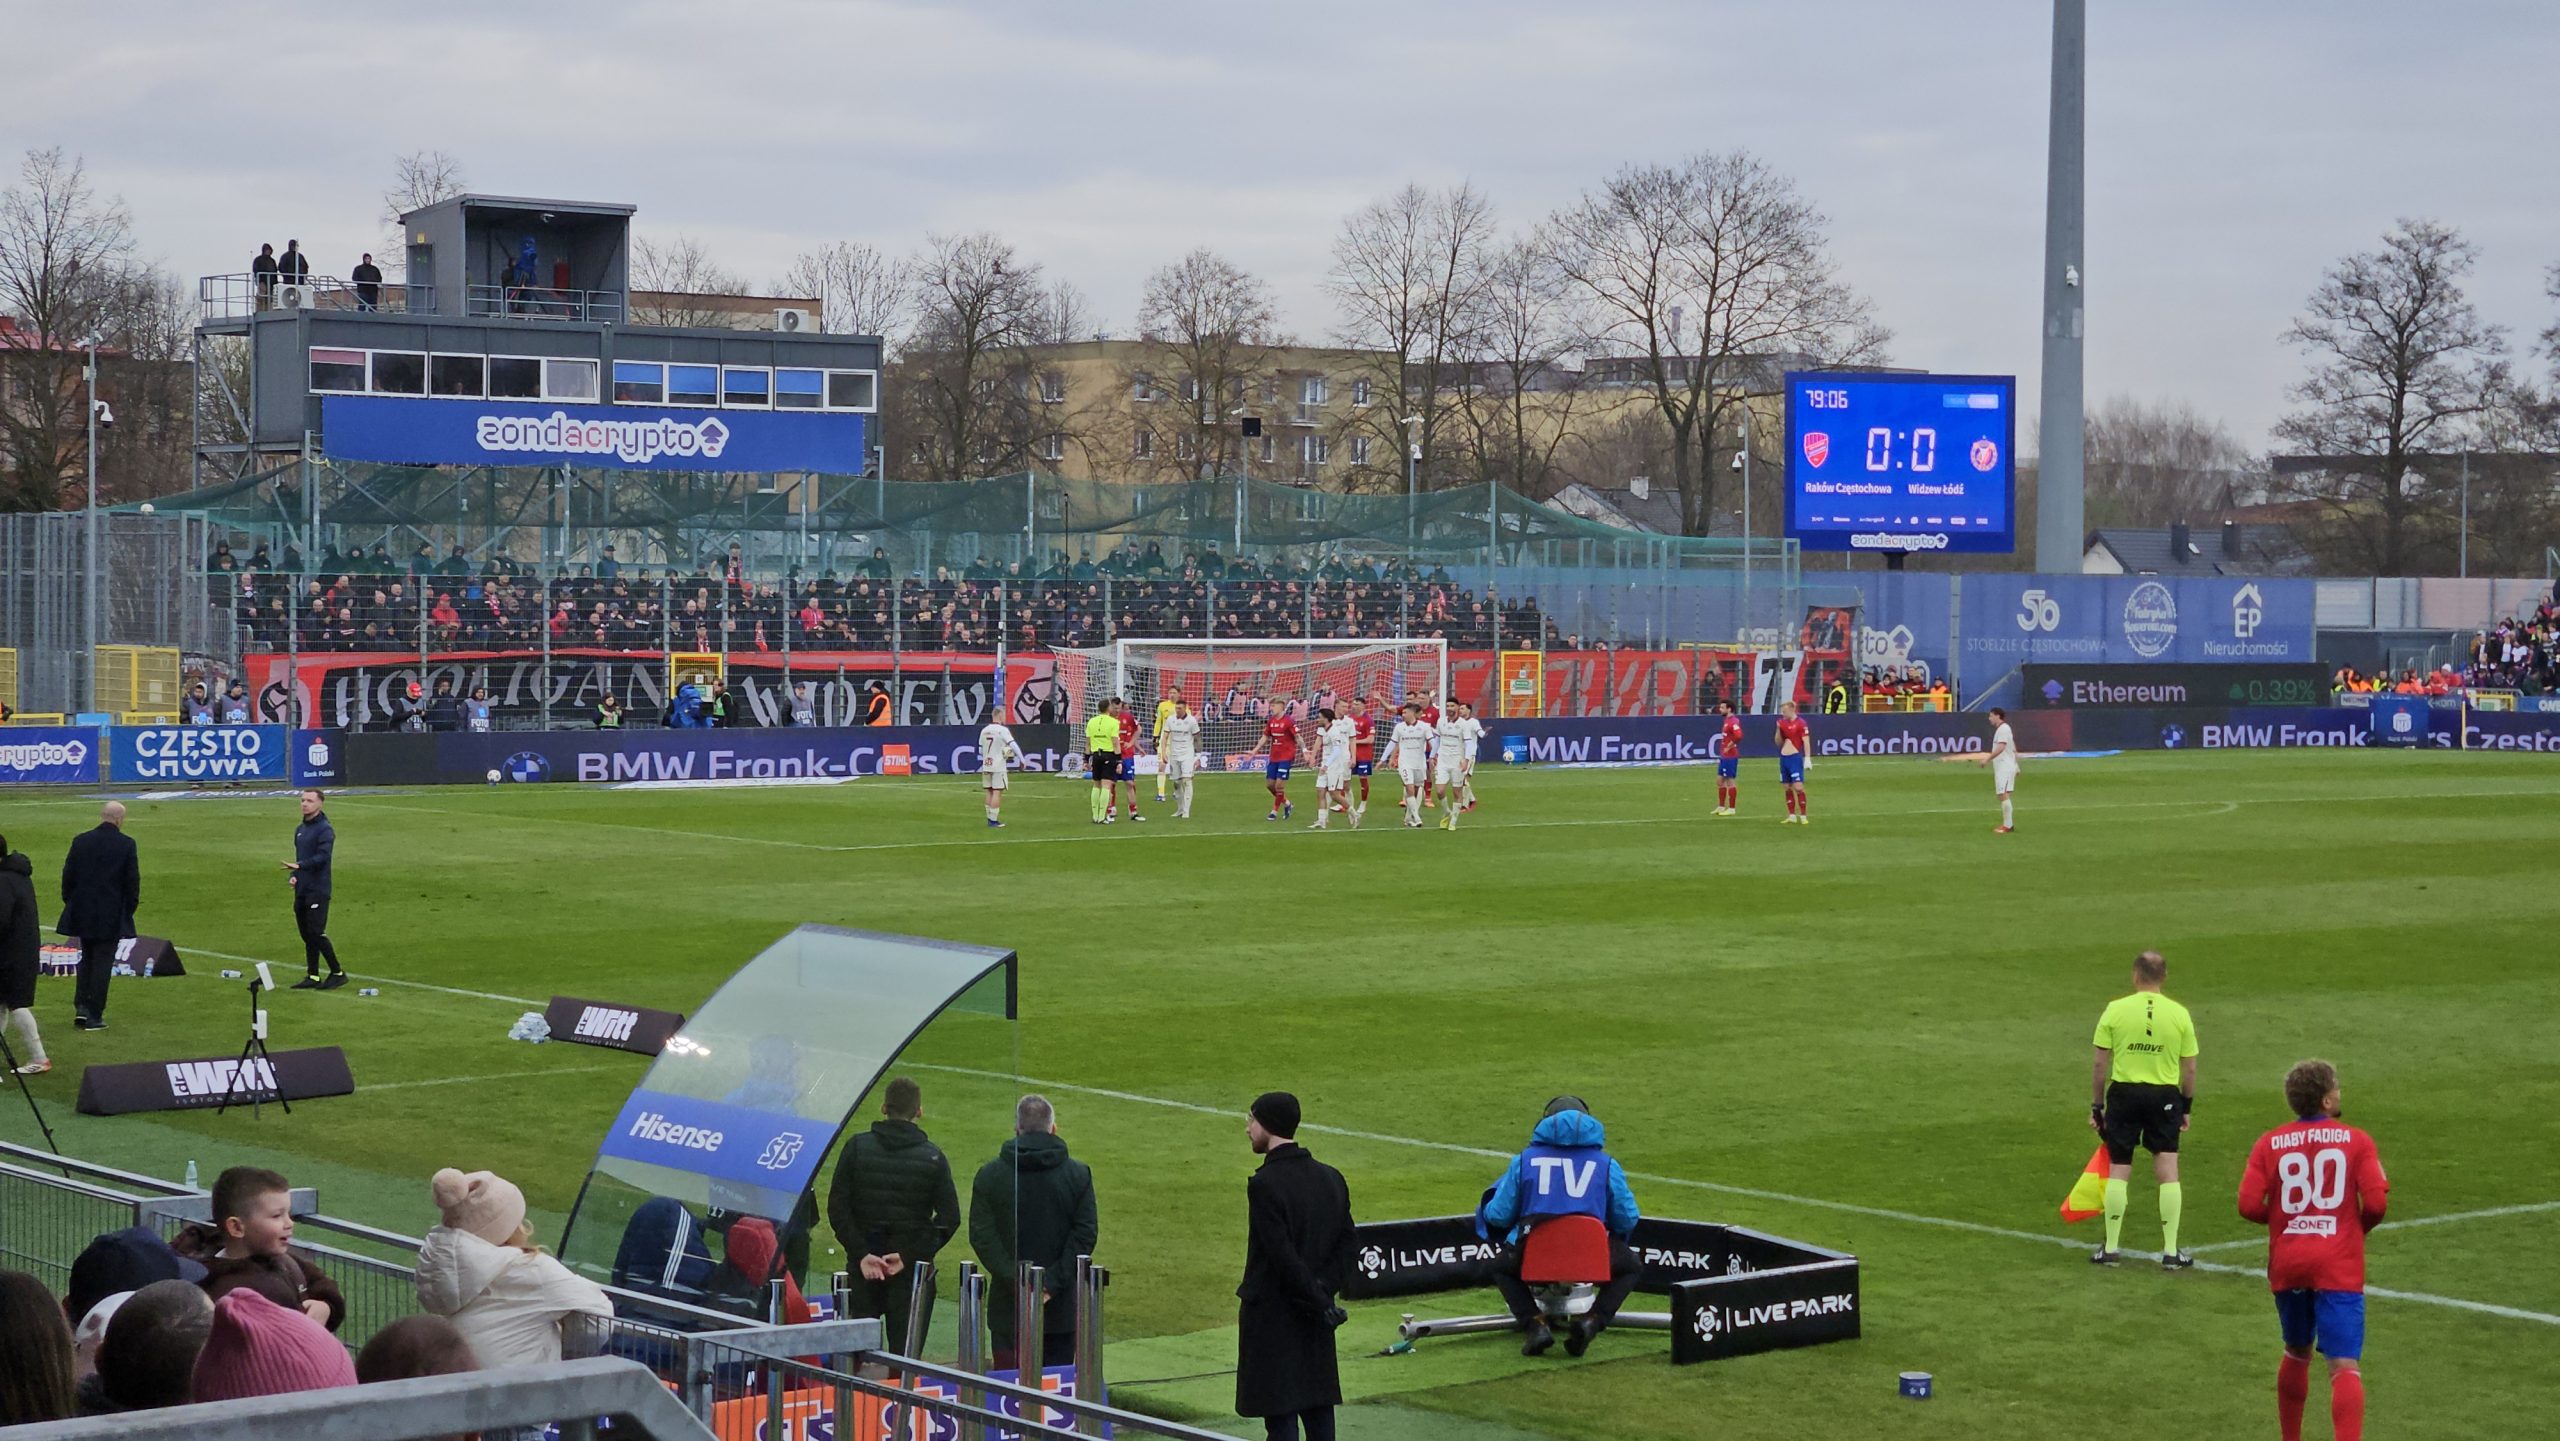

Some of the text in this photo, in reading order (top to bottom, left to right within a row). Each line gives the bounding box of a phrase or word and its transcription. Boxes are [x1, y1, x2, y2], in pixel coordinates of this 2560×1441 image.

[1805, 390, 1849, 409] 79:06
[482, 416, 696, 458] zondacrypto
[1805, 482, 1892, 496] Raków Częstochowa
[1908, 483, 1965, 495] Widzew Łódź
[1853, 534, 1935, 550] zondacrypto
[2235, 608, 2262, 637] EP
[2204, 640, 2288, 656] Nieruchomości
[2073, 679, 2317, 703] Ethereum 0.39%
[471, 719, 489, 727] FOTO
[986, 737, 994, 754] 7
[2203, 724, 2272, 748] BMW
[0, 746, 63, 767] rypto
[578, 751, 696, 782] BMW
[885, 755, 909, 767] STIHL
[1403, 769, 1409, 777] 3
[629, 1111, 724, 1152] Hisense
[2271, 1128, 2351, 1150] DIABY FADIGA
[1531, 1157, 1597, 1198] TV
[2278, 1148, 2347, 1214] 80
[1400, 1246, 1457, 1268] LIVE
[1461, 1243, 1502, 1263] PA
[1645, 1247, 1710, 1271] PARK
[1734, 1303, 1788, 1328] LIVE
[1791, 1293, 1853, 1319] PARK
